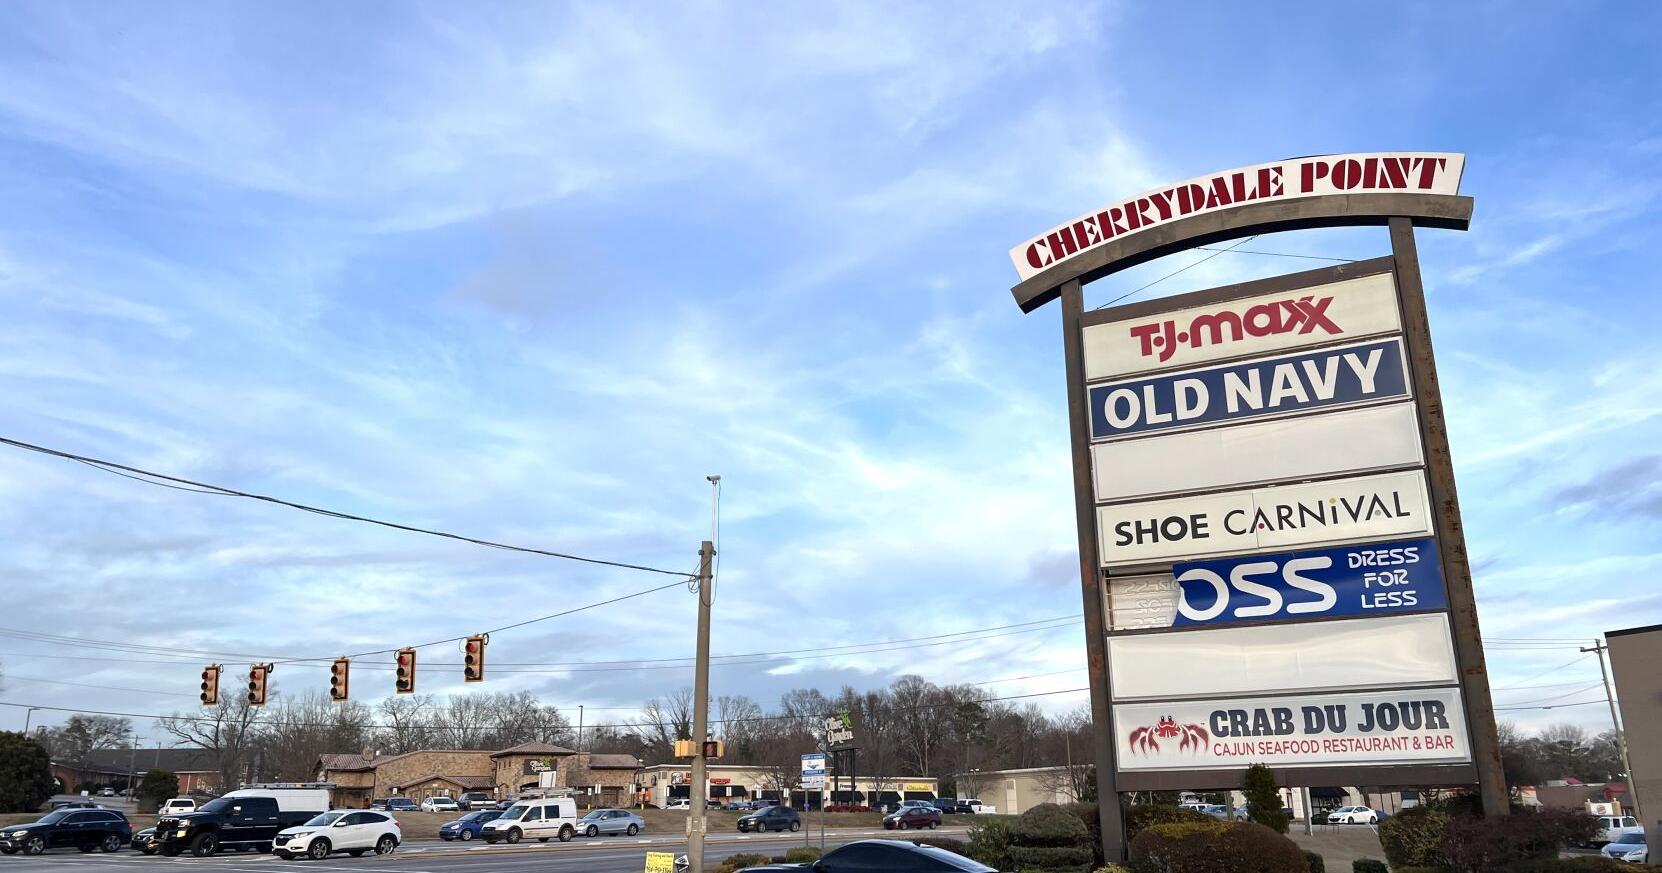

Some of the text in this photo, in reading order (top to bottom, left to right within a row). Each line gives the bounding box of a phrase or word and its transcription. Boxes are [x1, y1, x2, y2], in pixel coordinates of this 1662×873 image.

[1026, 157, 1446, 269] CHERRYDALE POINT
[1104, 348, 1383, 429] OLD NAVY
[1115, 513, 1210, 547] SHOE
[1348, 547, 1420, 568] DRESS
[1364, 569, 1409, 588] FOR
[1361, 590, 1418, 608] LESS
[1209, 700, 1450, 738] CRAB DU JOUR
[1213, 735, 1455, 757] CAJUN SEAFOOD RESTAURANT & BAR
